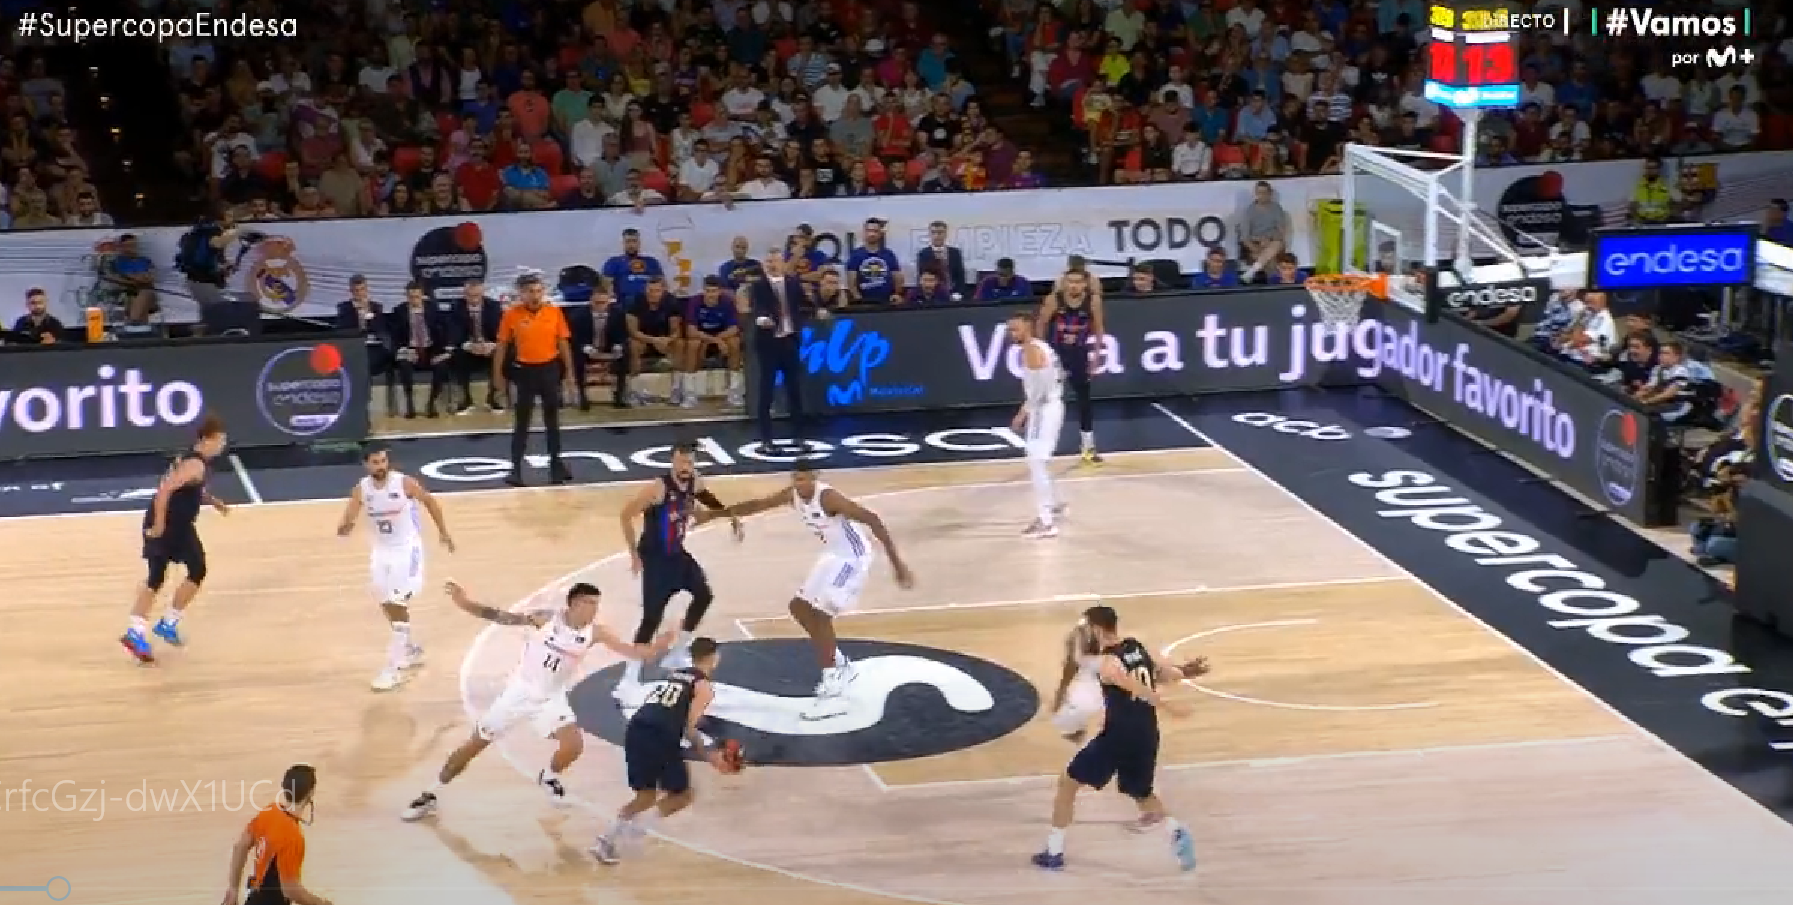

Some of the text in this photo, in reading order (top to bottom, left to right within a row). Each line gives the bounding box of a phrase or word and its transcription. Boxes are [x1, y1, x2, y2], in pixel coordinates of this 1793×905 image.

[1107, 215, 1227, 252] TODO
[1604, 244, 1744, 277] endesa
[1446, 283, 1538, 308] endesa
[957, 323, 1126, 381] Voa
[1140, 330, 1185, 372] a
[1195, 313, 1269, 369] tu
[1452, 343, 1576, 458] favorito
[1231, 412, 1352, 440] acb
[1348, 469, 1753, 678] supercopa
